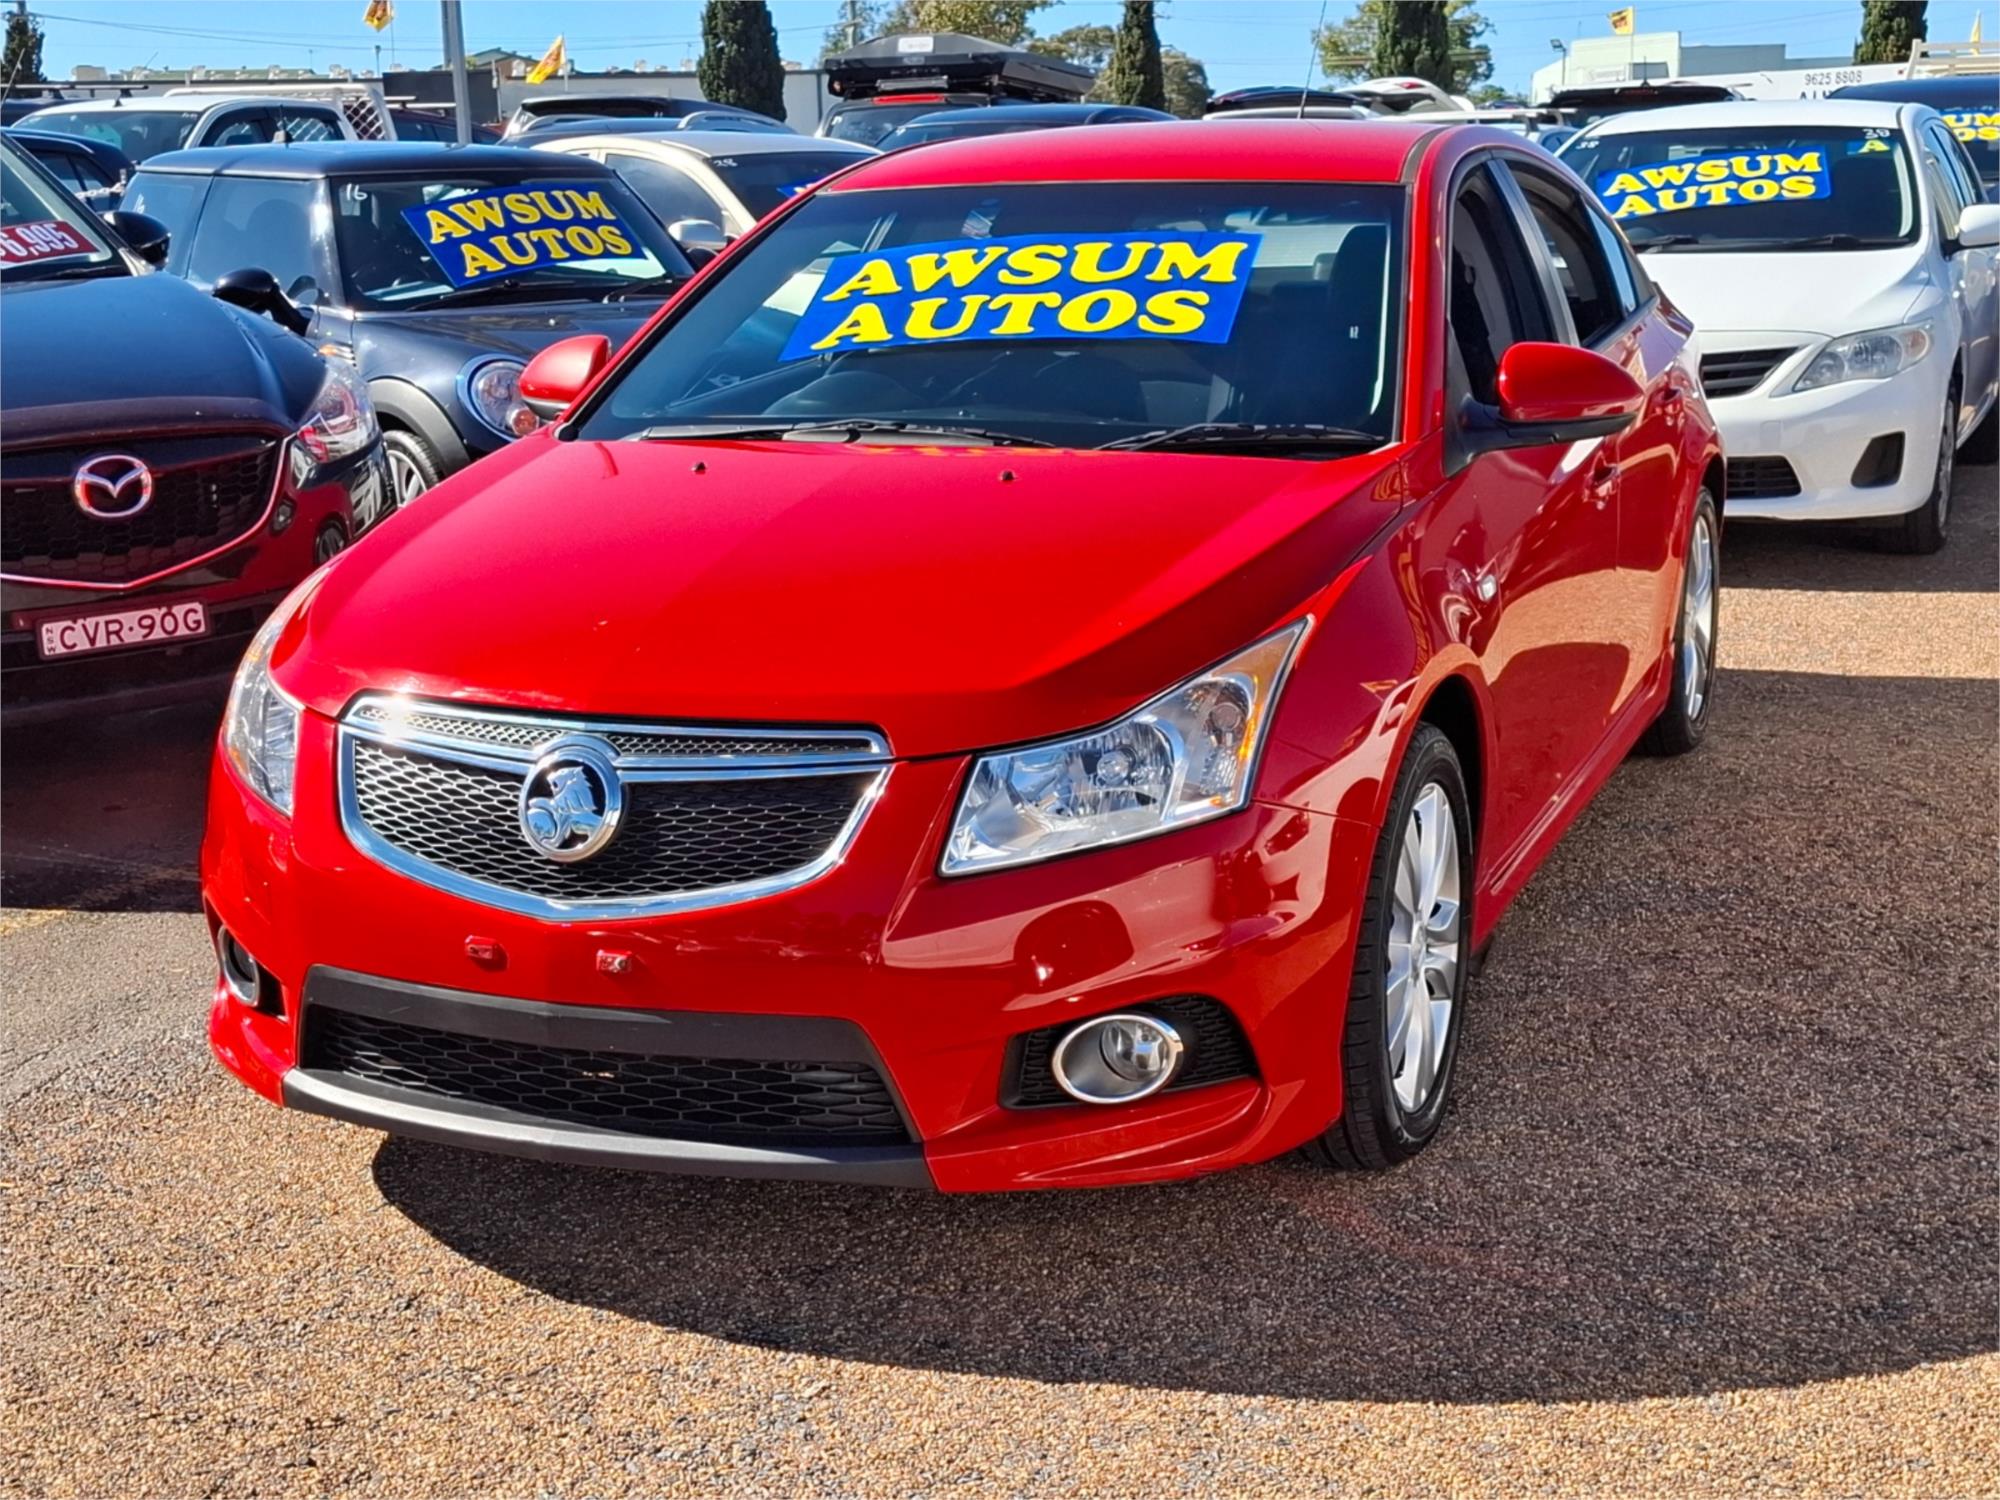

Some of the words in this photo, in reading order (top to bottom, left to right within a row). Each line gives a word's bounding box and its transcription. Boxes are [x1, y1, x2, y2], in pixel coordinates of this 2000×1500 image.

[1804, 72, 1832, 86] 9625
[346, 183, 368, 201] 16
[1603, 151, 1823, 197] AWSUM
[1611, 175, 1816, 218] AUTOS
[0, 222, 79, 257] 6,995
[426, 190, 617, 244] AWSUM
[460, 225, 632, 277] AUTOS
[822, 241, 1249, 302] AWSUM
[810, 289, 1210, 350] AUTOS
